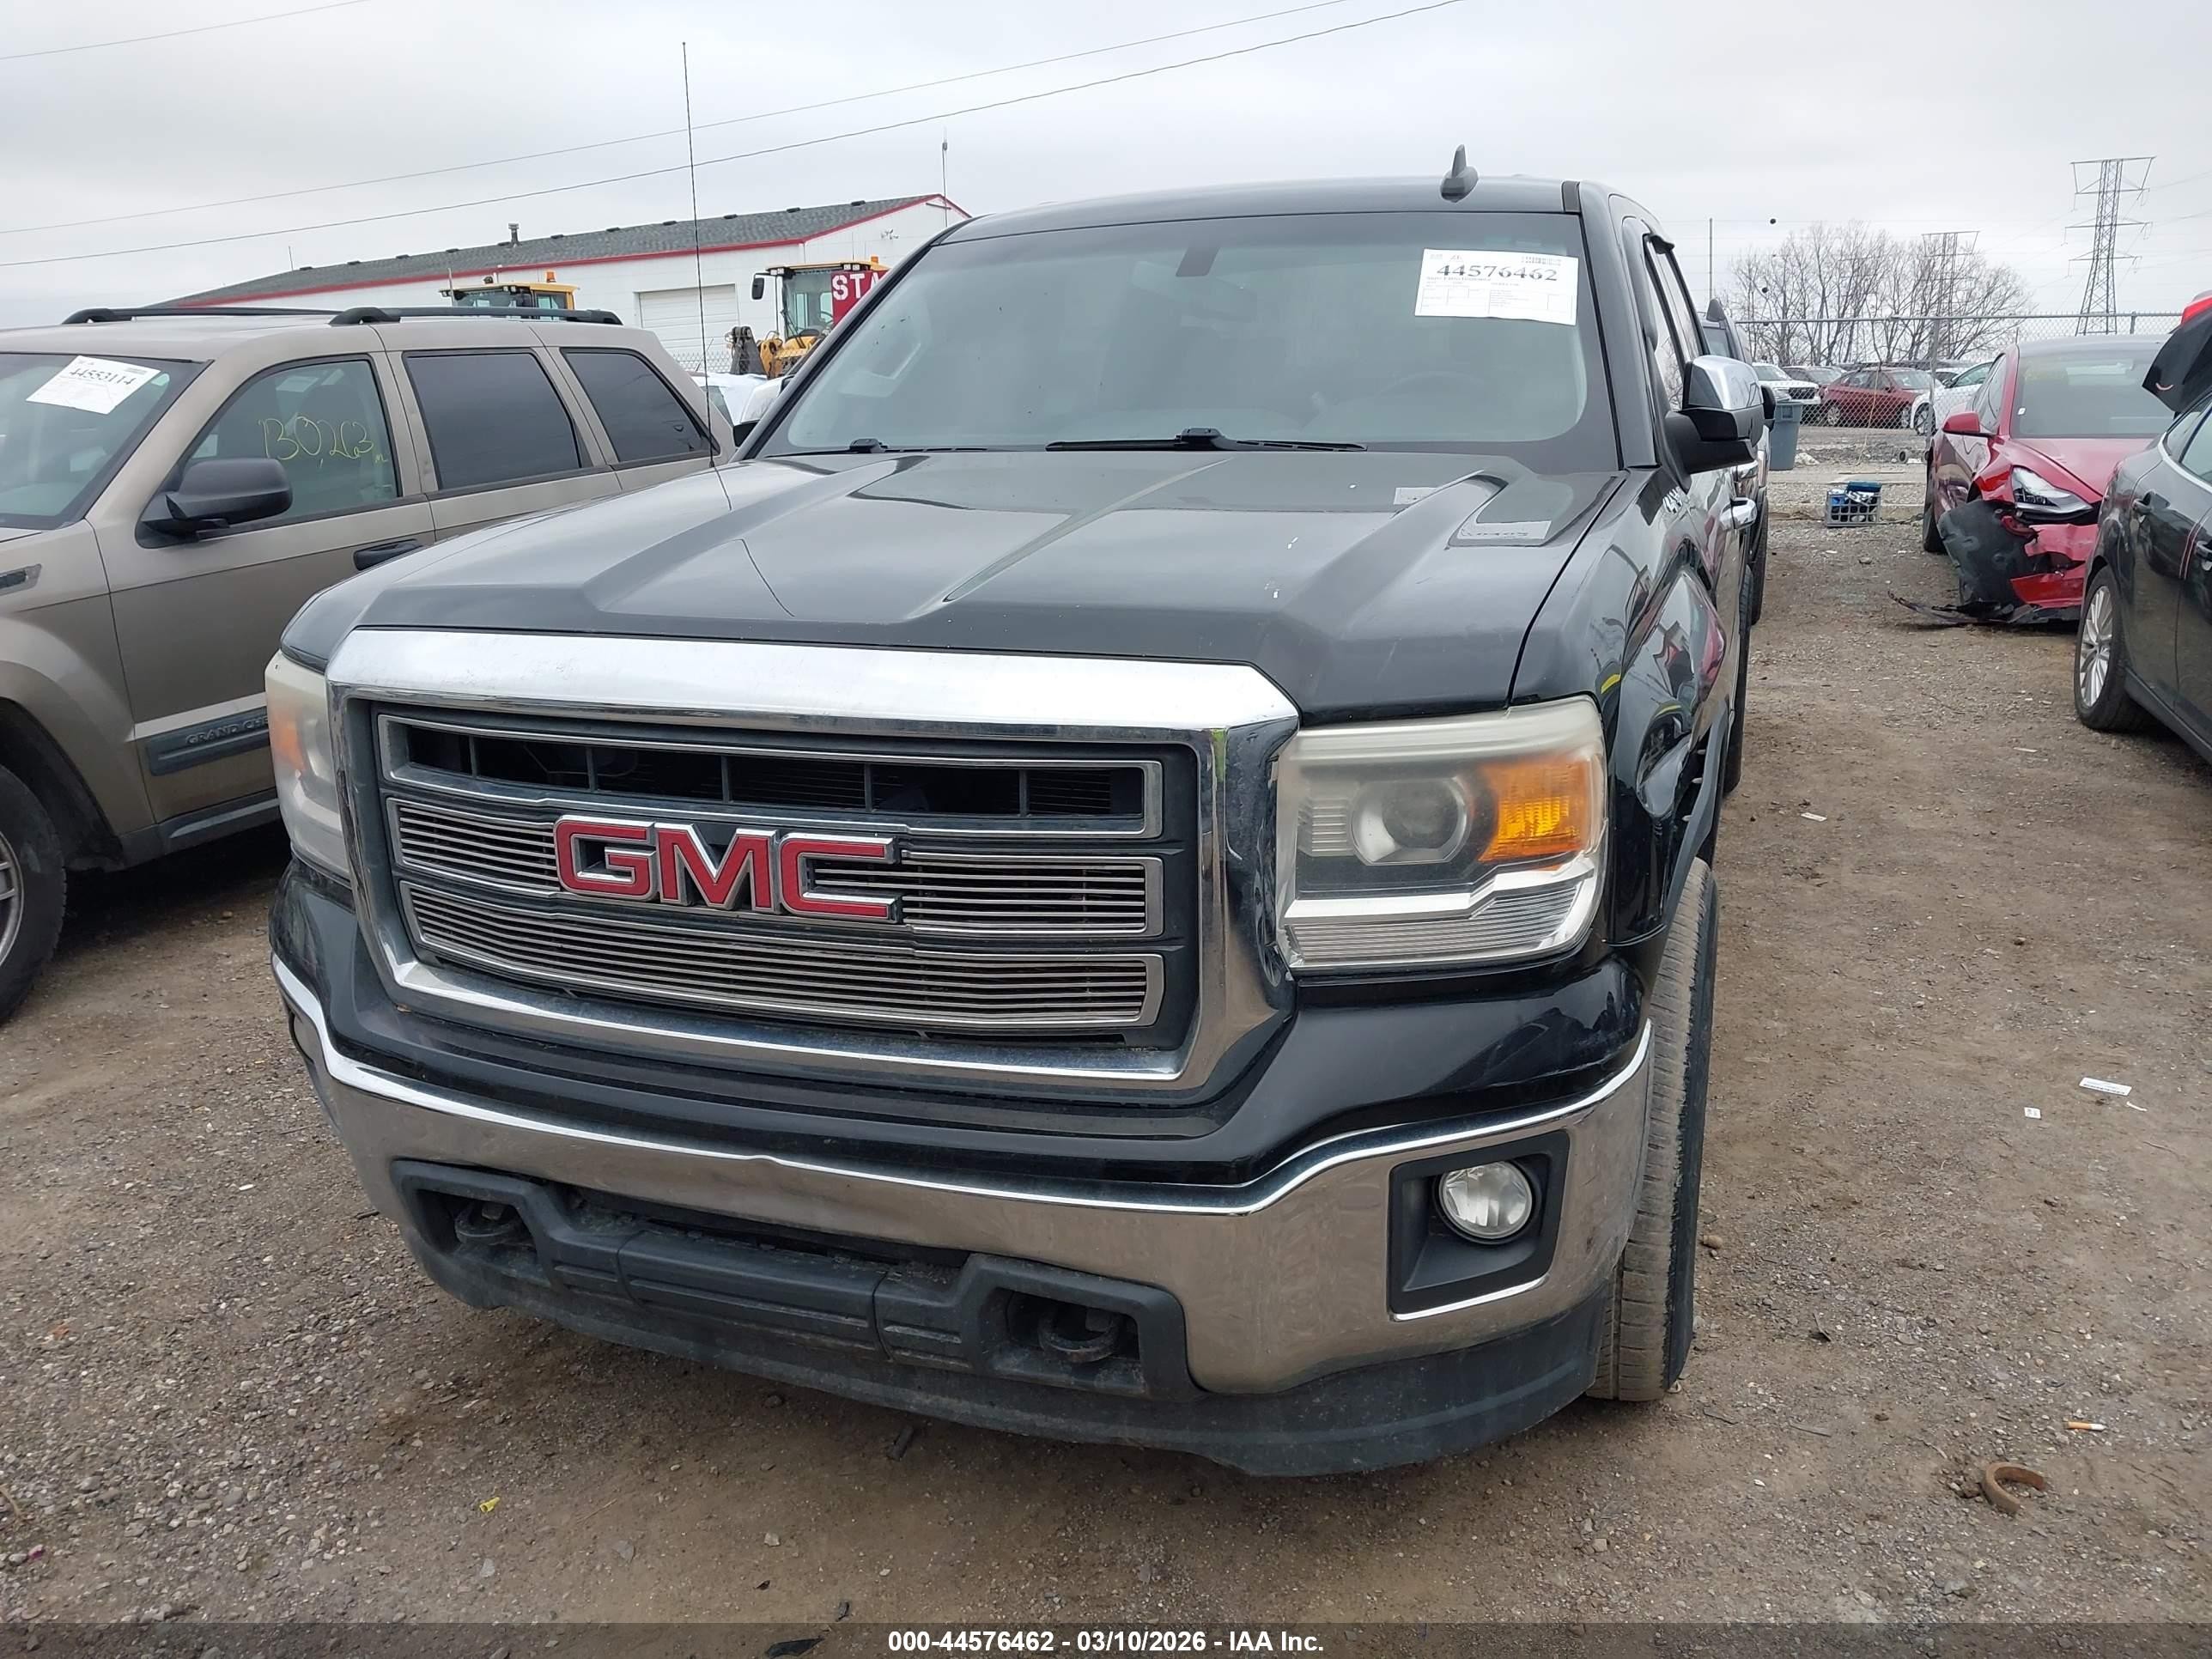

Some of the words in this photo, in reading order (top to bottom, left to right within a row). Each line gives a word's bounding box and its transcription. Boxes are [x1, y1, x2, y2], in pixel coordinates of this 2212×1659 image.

[1437, 264, 1558, 282] 44576462
[69, 368, 137, 386] 44553114
[185, 723, 240, 744] GRAND
[554, 814, 901, 924] GMC
